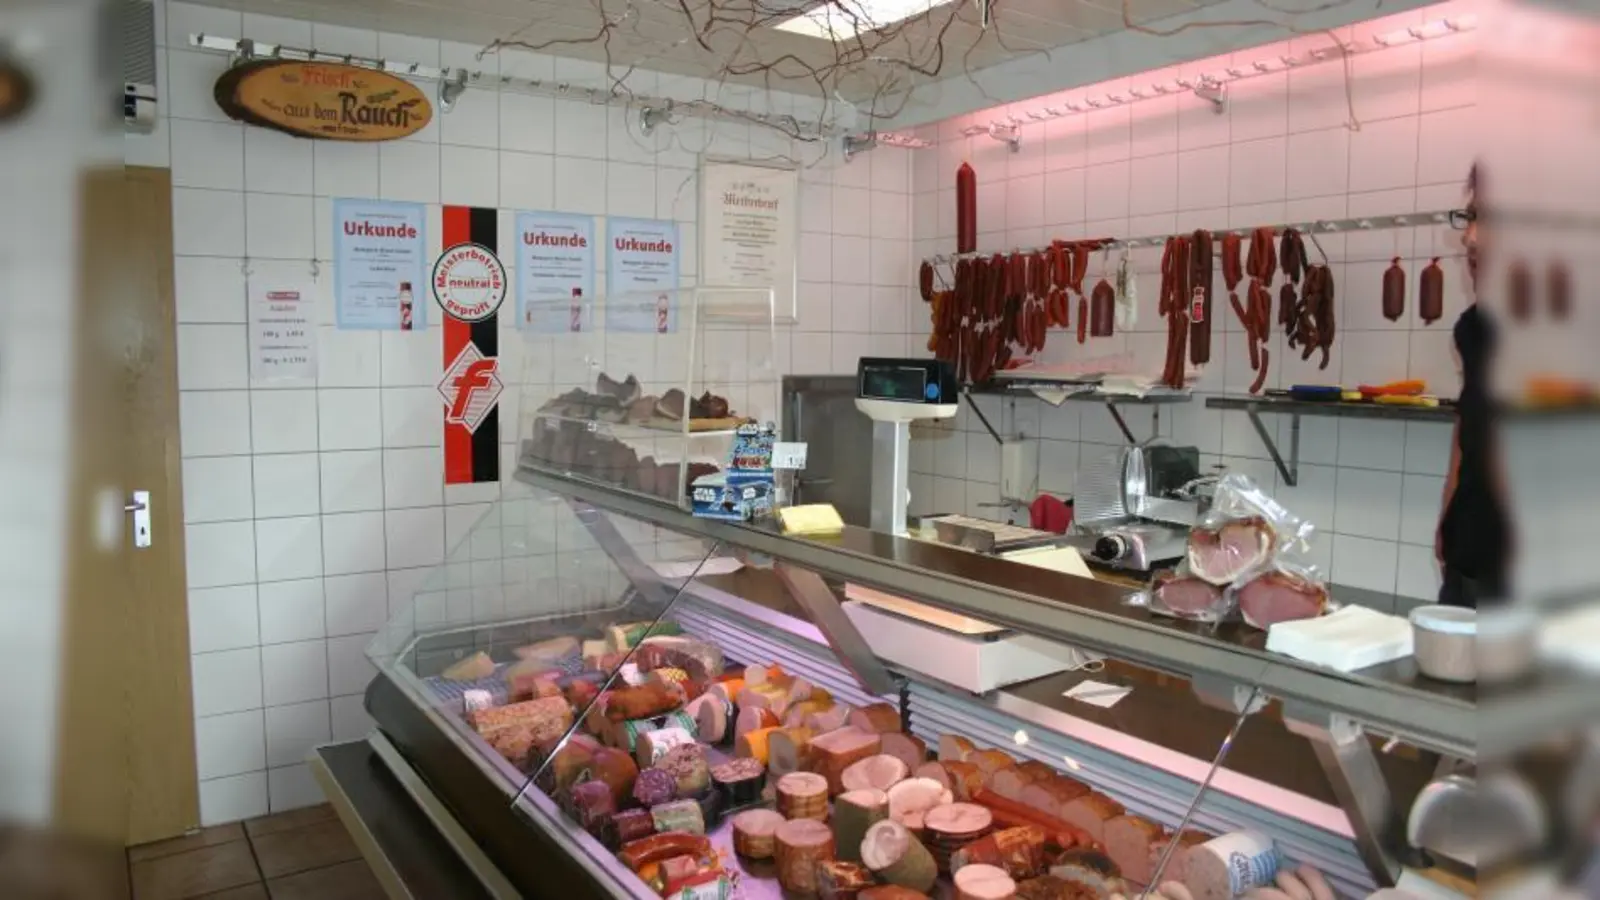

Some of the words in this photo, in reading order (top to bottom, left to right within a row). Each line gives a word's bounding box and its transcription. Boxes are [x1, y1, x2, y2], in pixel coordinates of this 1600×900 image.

[313, 102, 337, 121] dem
[339, 92, 418, 128] Rauch
[344, 220, 417, 239] Urkunde
[523, 231, 588, 248] Urkunde
[615, 237, 673, 253] Urkunde
[437, 249, 501, 289] Meisterbetrieb
[449, 279, 490, 289] neutral
[447, 299, 490, 316] geprüft
